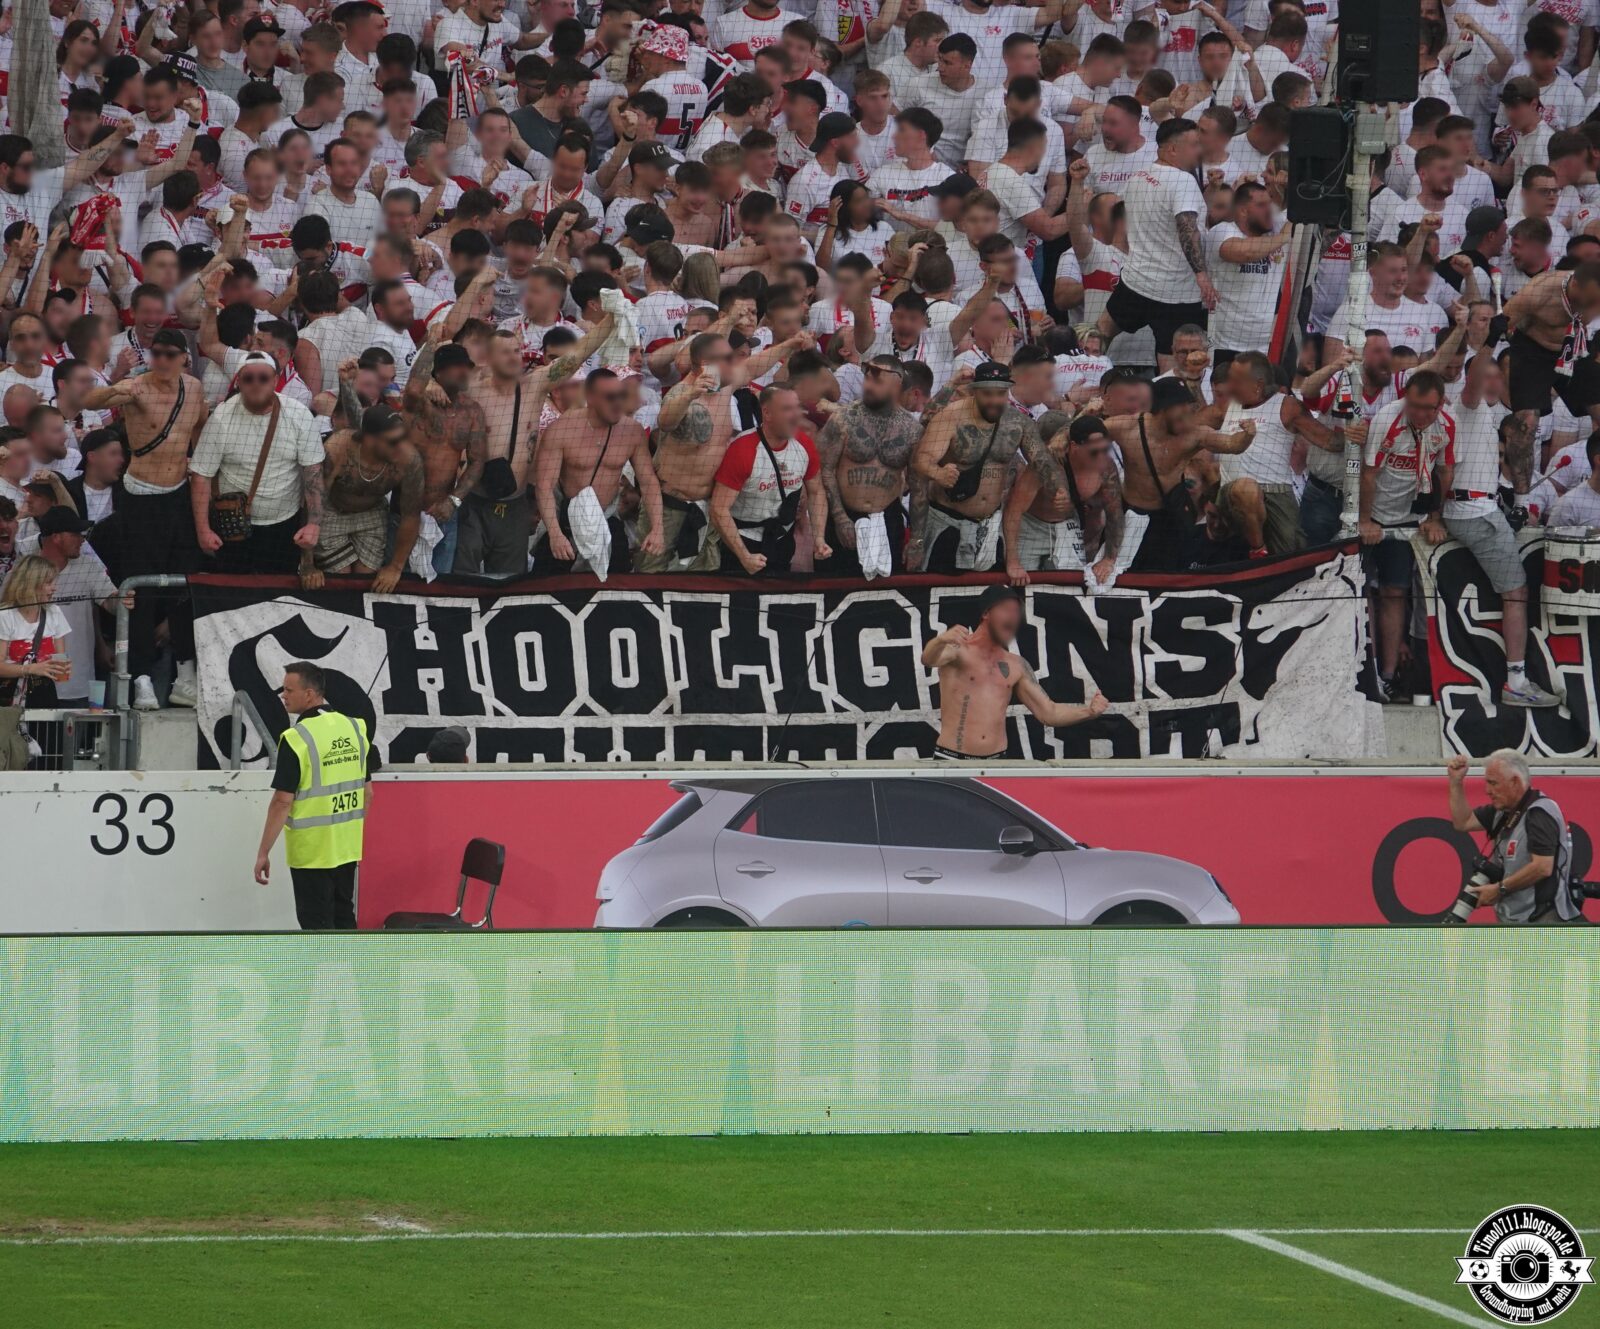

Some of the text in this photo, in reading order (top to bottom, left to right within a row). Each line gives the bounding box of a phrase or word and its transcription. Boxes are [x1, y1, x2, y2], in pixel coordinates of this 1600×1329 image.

[682, 102, 699, 148] 5
[366, 590, 1246, 718] HOOLIGNS
[331, 737, 351, 750] SDS
[90, 793, 176, 856] 33
[332, 791, 358, 814] 2478
[50, 956, 577, 1107] LIBARE
[772, 952, 1290, 1098] LIBARE
